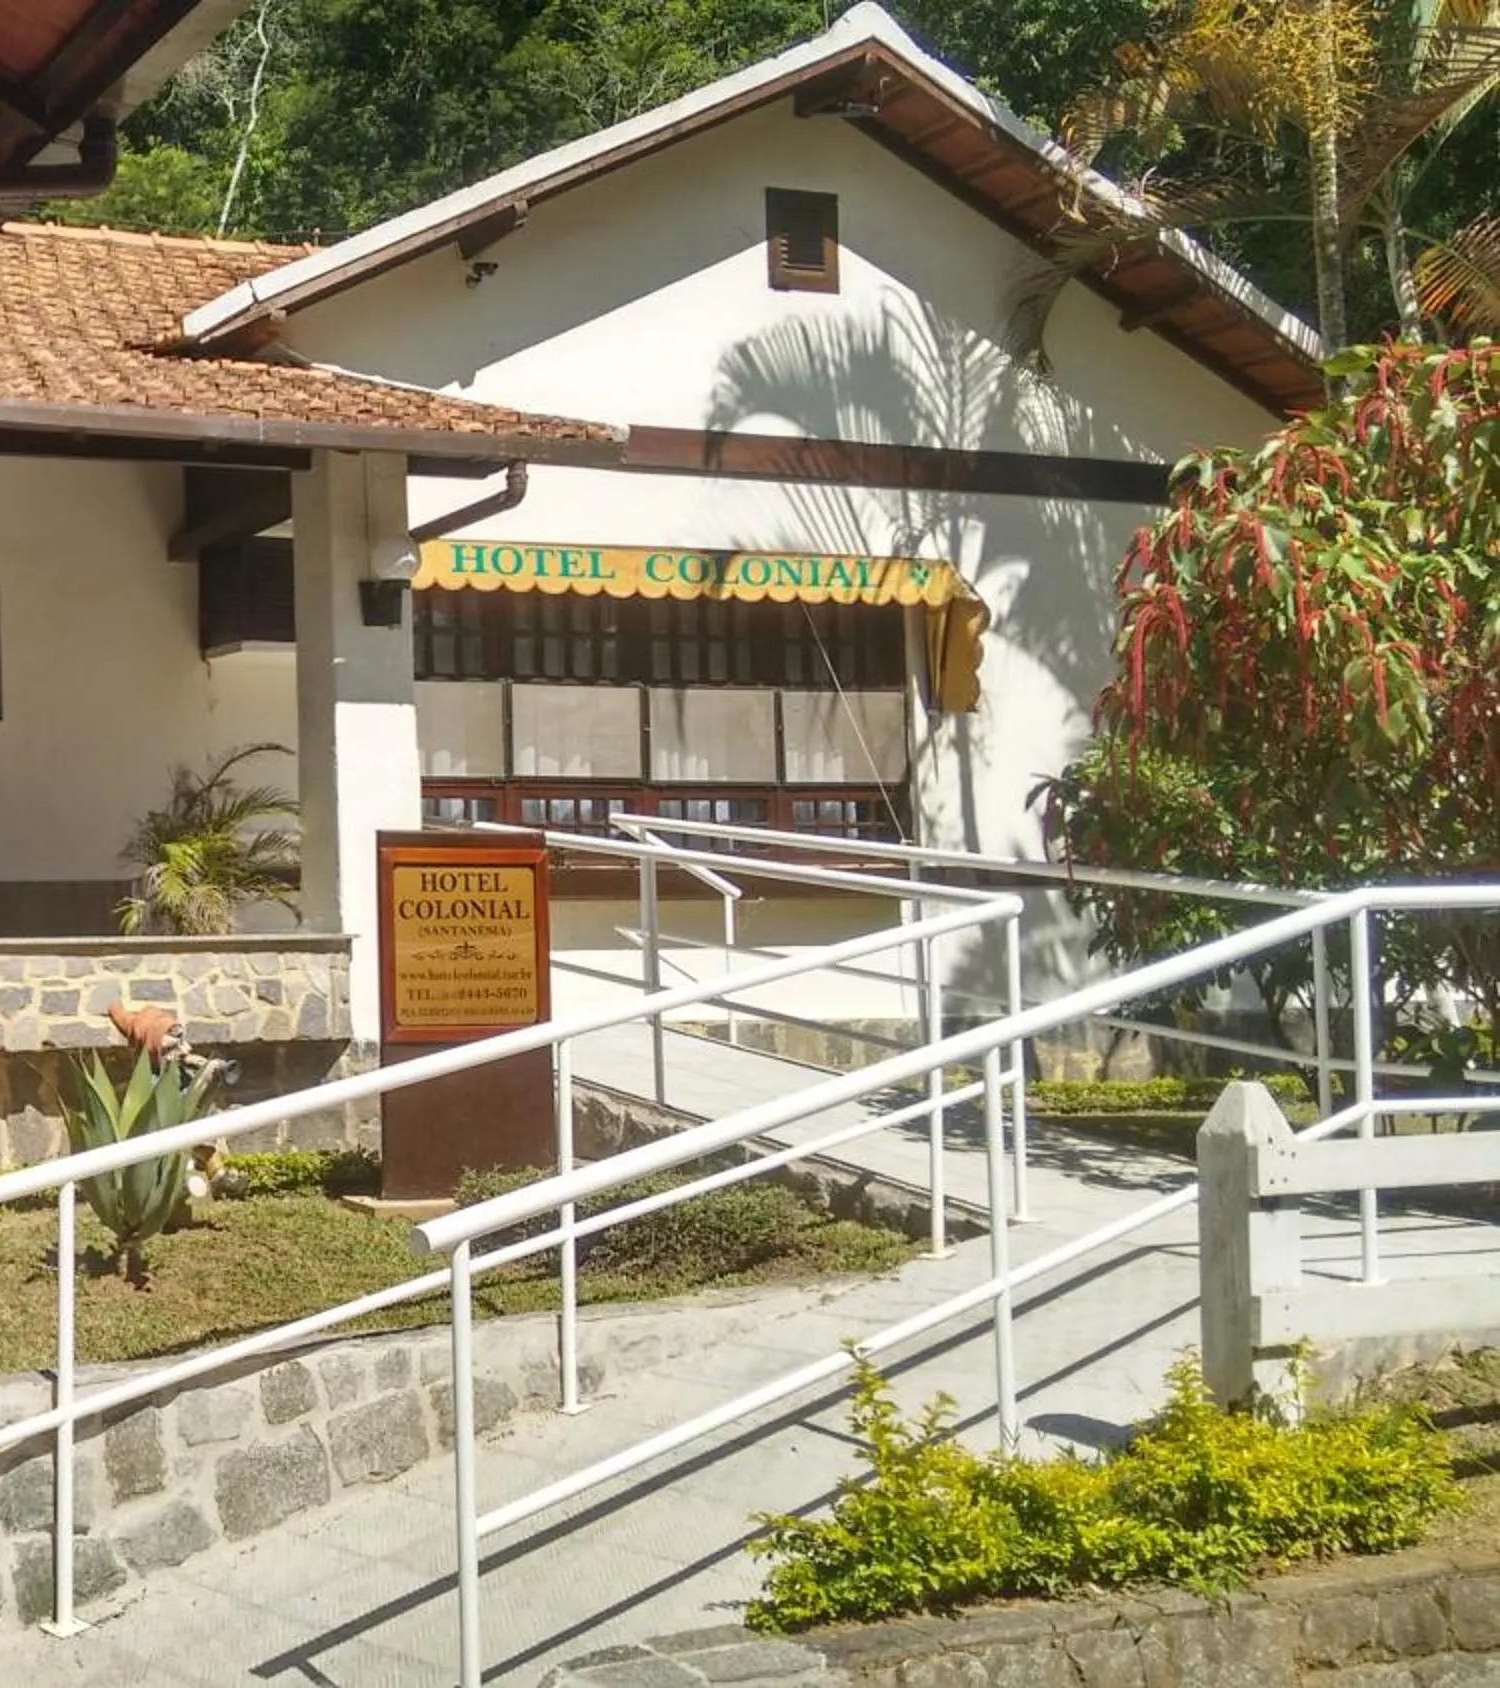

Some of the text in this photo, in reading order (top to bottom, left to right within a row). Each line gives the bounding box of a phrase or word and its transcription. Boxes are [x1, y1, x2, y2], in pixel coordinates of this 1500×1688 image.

[451, 543, 883, 589] HOTEL COLONIAL
[420, 872, 508, 893] HOTEL
[398, 899, 530, 921] COLONIAL
